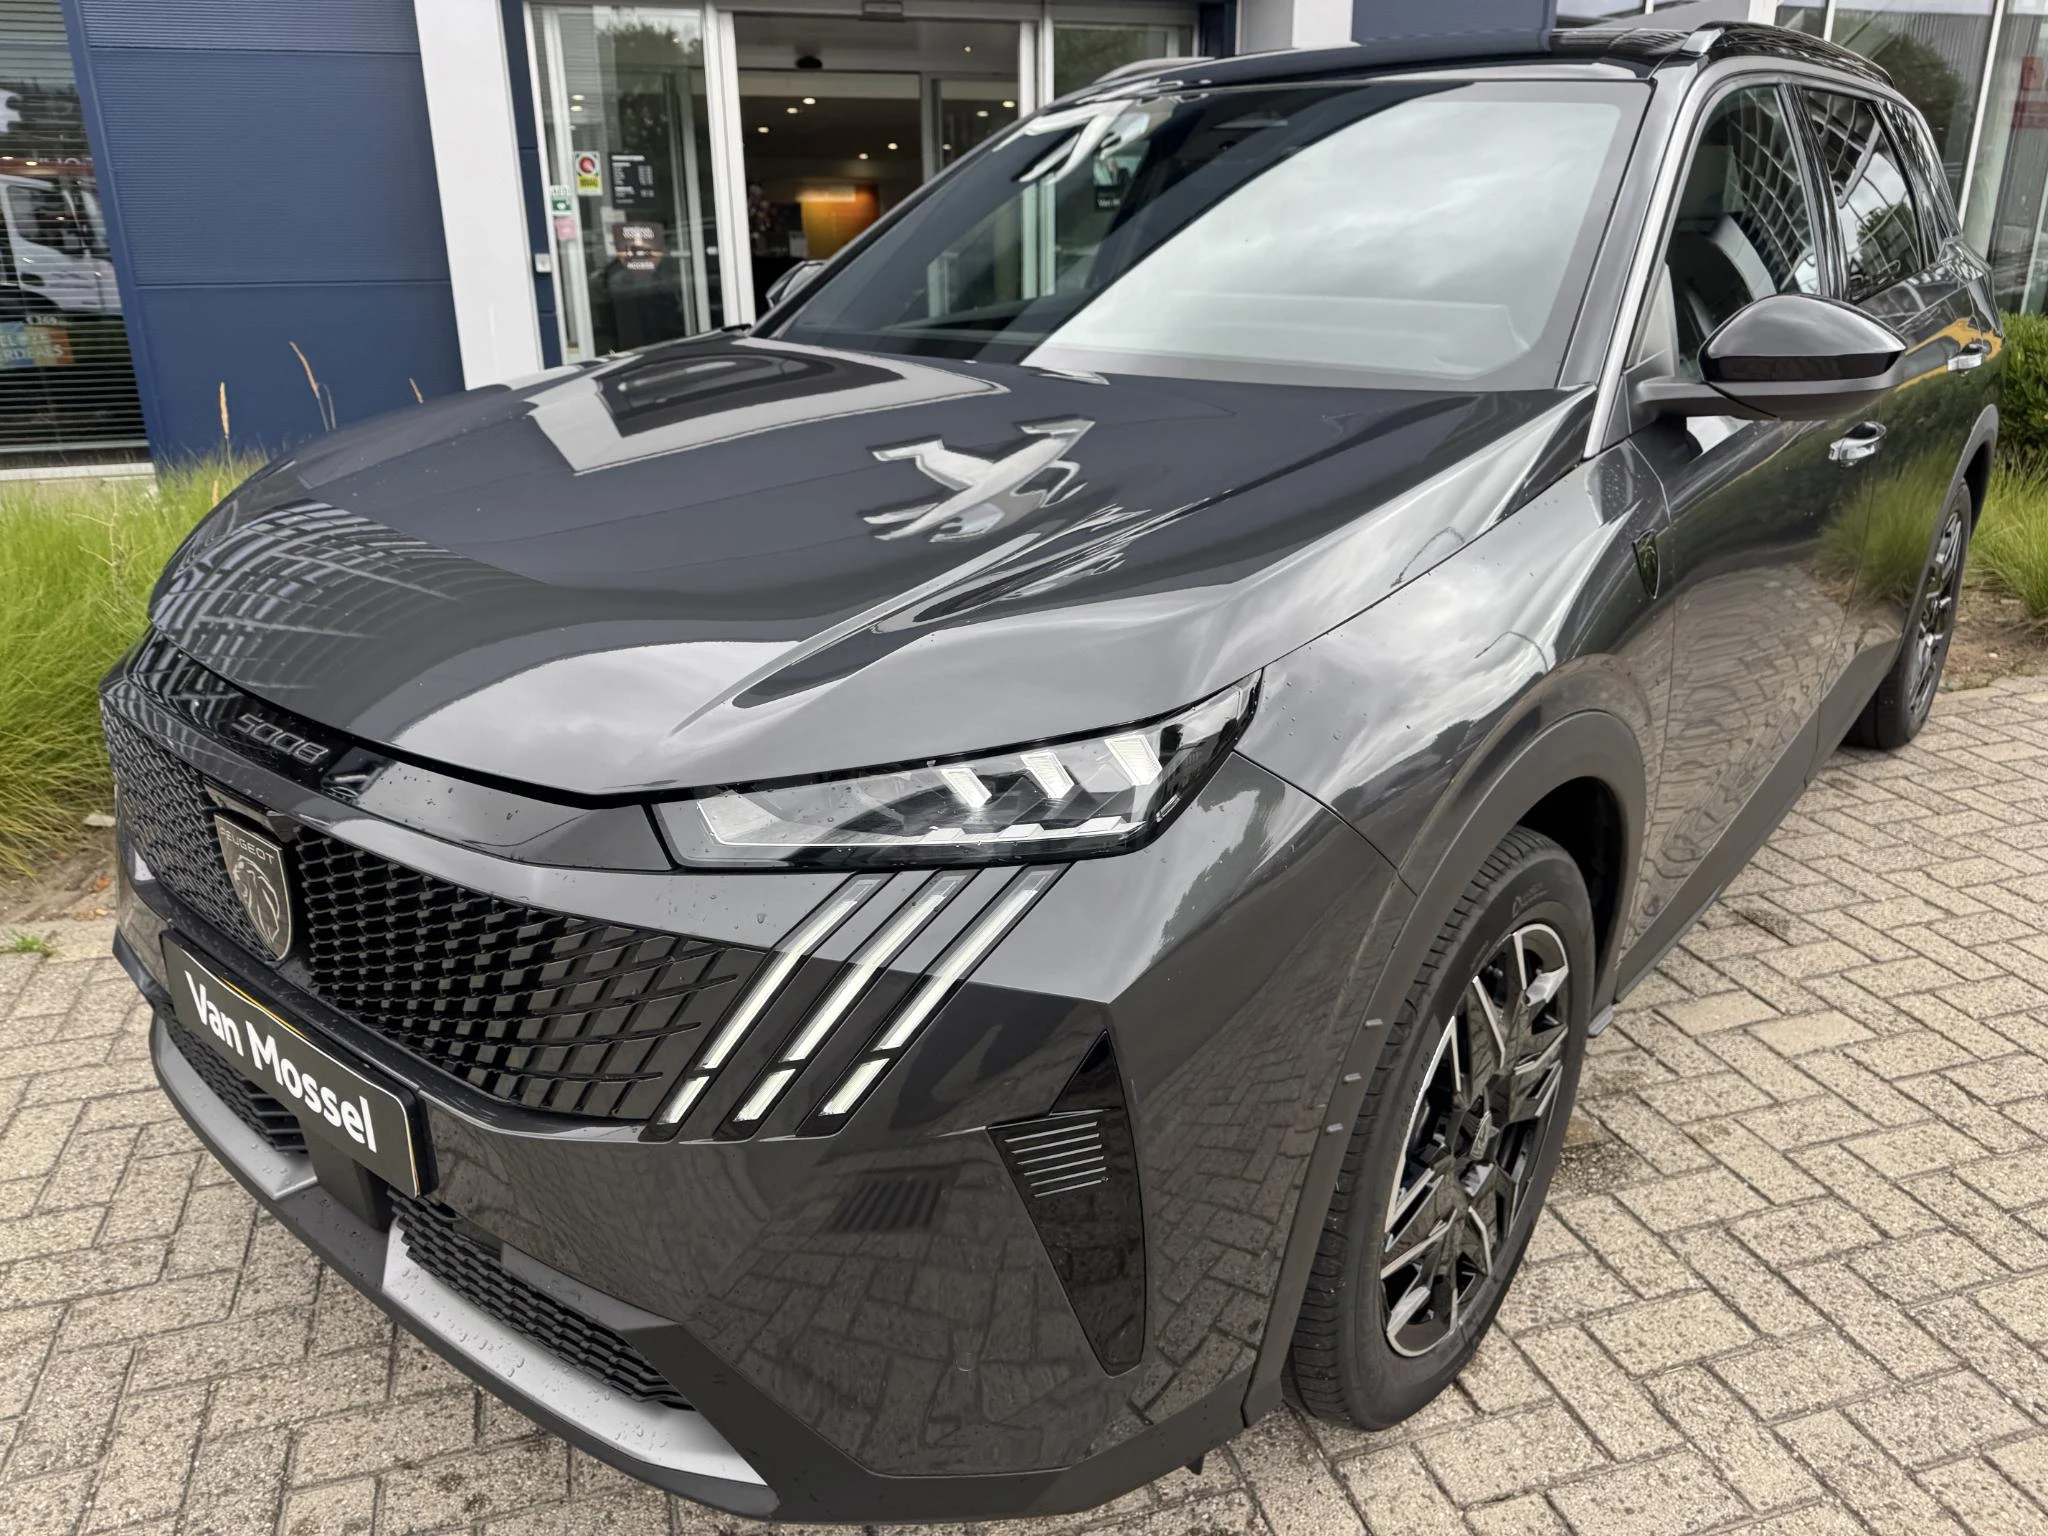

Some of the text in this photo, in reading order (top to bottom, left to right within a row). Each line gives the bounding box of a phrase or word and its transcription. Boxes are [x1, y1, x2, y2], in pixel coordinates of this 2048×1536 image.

[232, 713, 329, 764] 5008
[220, 827, 275, 865] PEUGEOT
[184, 970, 377, 1154] Van Mossel
